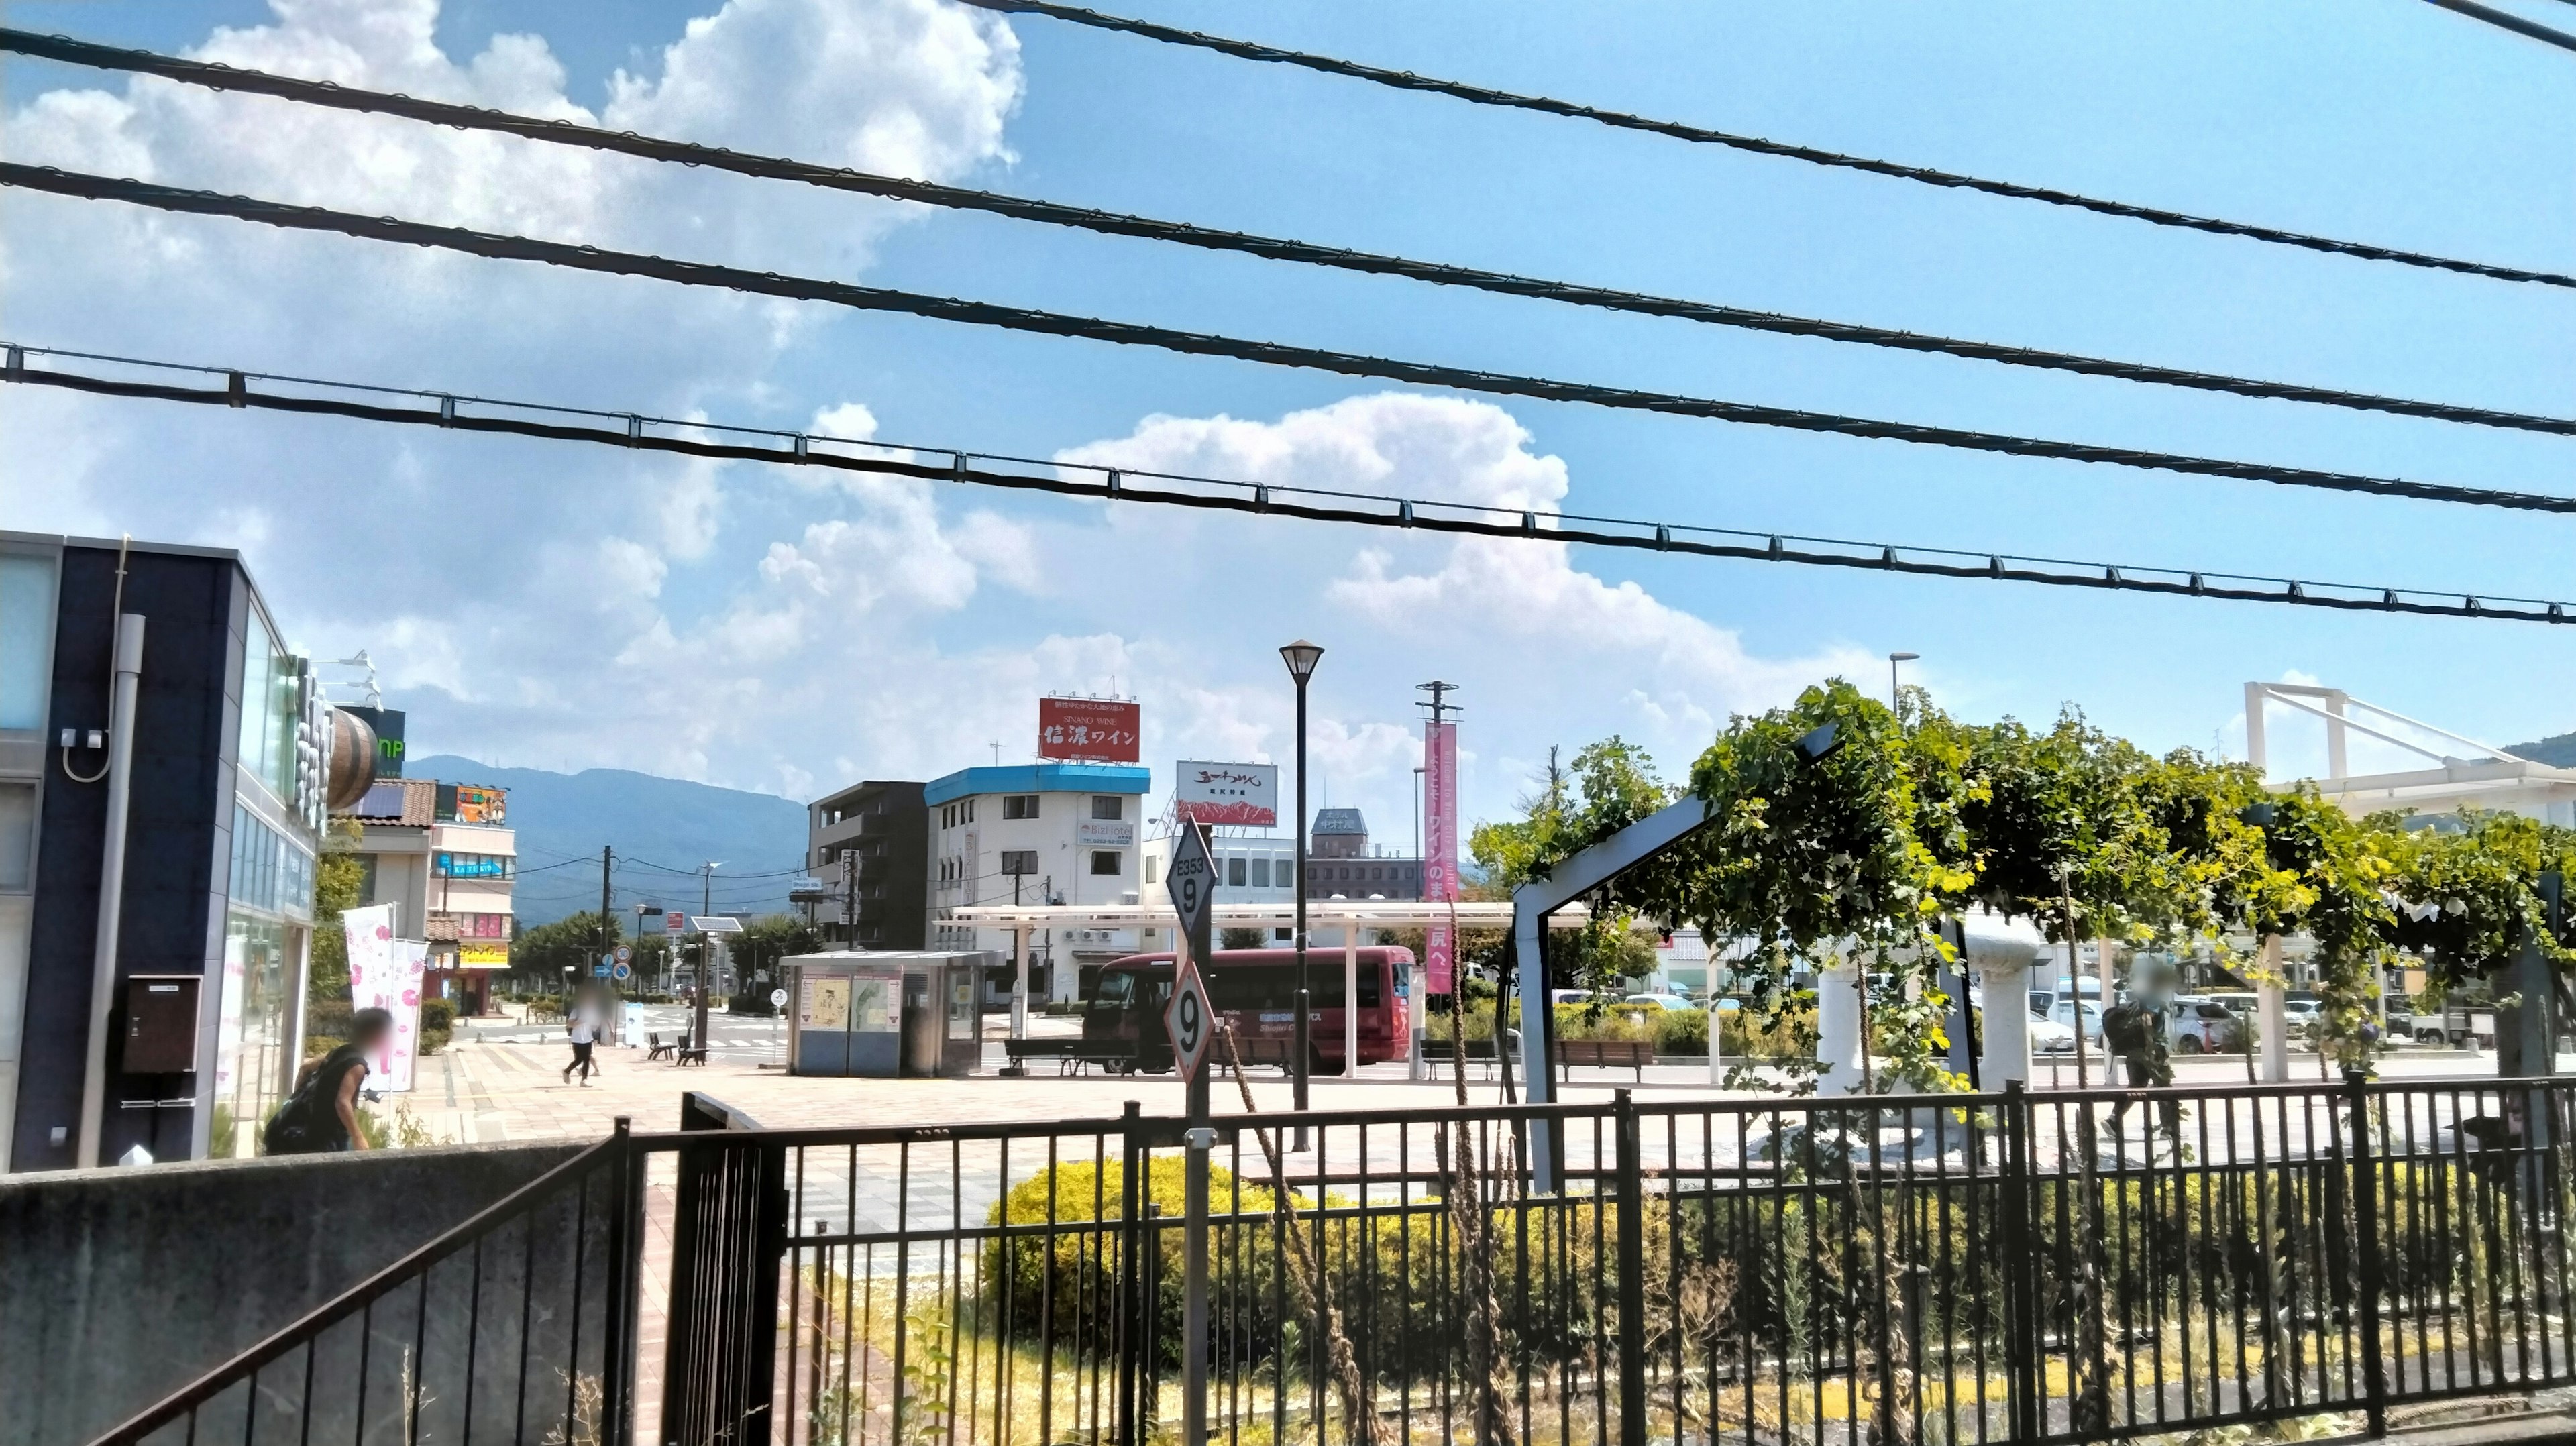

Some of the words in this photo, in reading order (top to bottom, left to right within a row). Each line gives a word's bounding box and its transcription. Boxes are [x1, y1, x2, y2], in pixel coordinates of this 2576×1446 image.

[1063, 716, 1093, 724] SINANO
[1097, 718, 1118, 726] WINE
[1044, 724, 1135, 746] 信濃ワイン
[1444, 750, 1453, 783] Welcome
[1444, 789, 1452, 797] to
[1444, 801, 1452, 820] Wine
[1320, 819, 1354, 830] 中村屋
[1444, 825, 1453, 844] City
[1177, 856, 1204, 876] E353
[1445, 848, 1455, 885] SHIOJIRI
[1183, 878, 1197, 913] 9
[619, 950, 629, 958] 30
[1179, 989, 1199, 1053] 9
